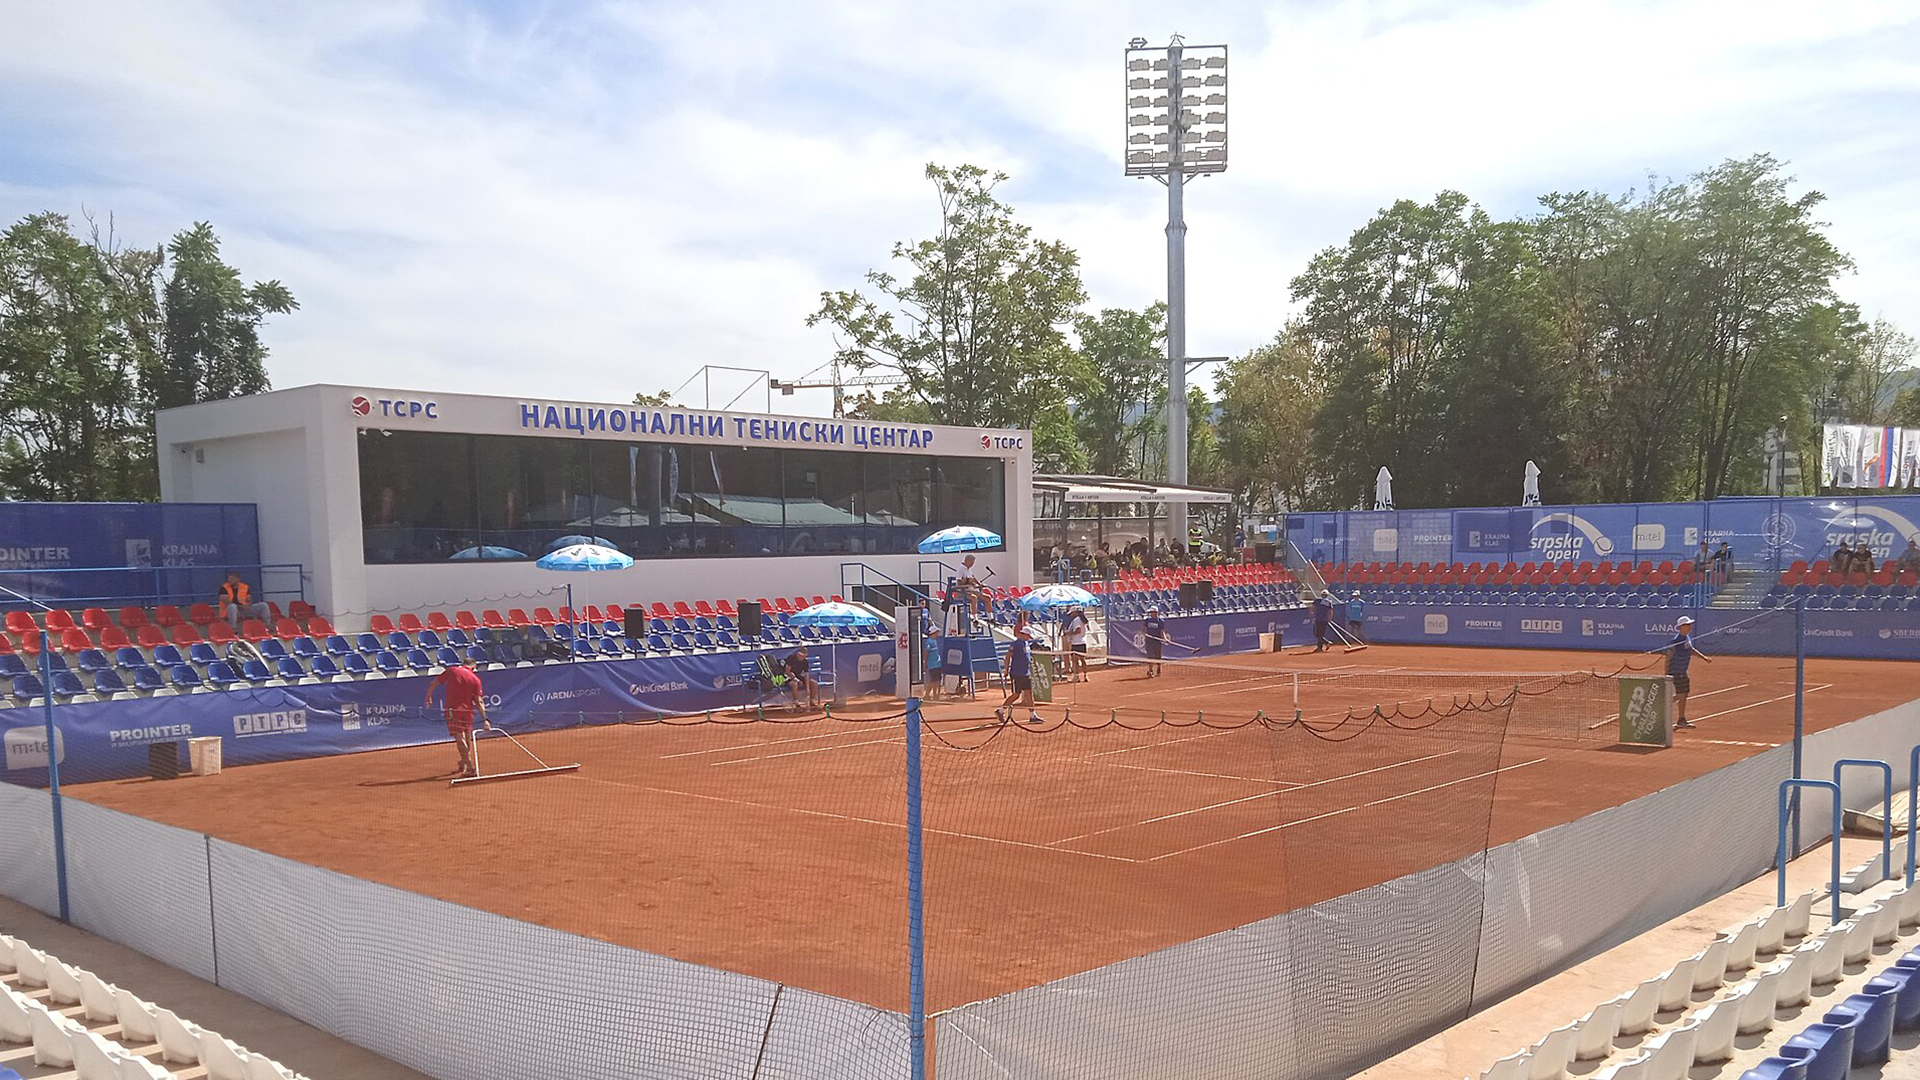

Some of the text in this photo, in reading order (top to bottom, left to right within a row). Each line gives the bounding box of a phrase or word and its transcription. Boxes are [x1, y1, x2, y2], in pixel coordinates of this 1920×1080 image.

[378, 399, 438, 419] ТСРС
[520, 403, 934, 449] НАЦИОНАЛНИ ТЕНИСКИ ЦЕНТАР
[993, 436, 1024, 450] ТСРС
[1413, 534, 1453, 542] PROINTER
[1530, 533, 1584, 552] srpska
[1636, 531, 1661, 541] m:tel
[161, 544, 218, 555] KRAJINA
[162, 558, 195, 568] KLAS
[1546, 550, 1580, 563] open
[1465, 620, 1502, 628] PROINTER
[1645, 623, 1679, 632] LANAC
[1804, 628, 1853, 637] UniCredit Bank
[639, 681, 688, 694] UniCredit Bank
[1625, 687, 1645, 726] ATP
[1634, 683, 1659, 738] CHALLENGER
[1645, 711, 1658, 735] TOUR
[109, 723, 193, 742] PROINTER
[12, 740, 50, 755] m:te
